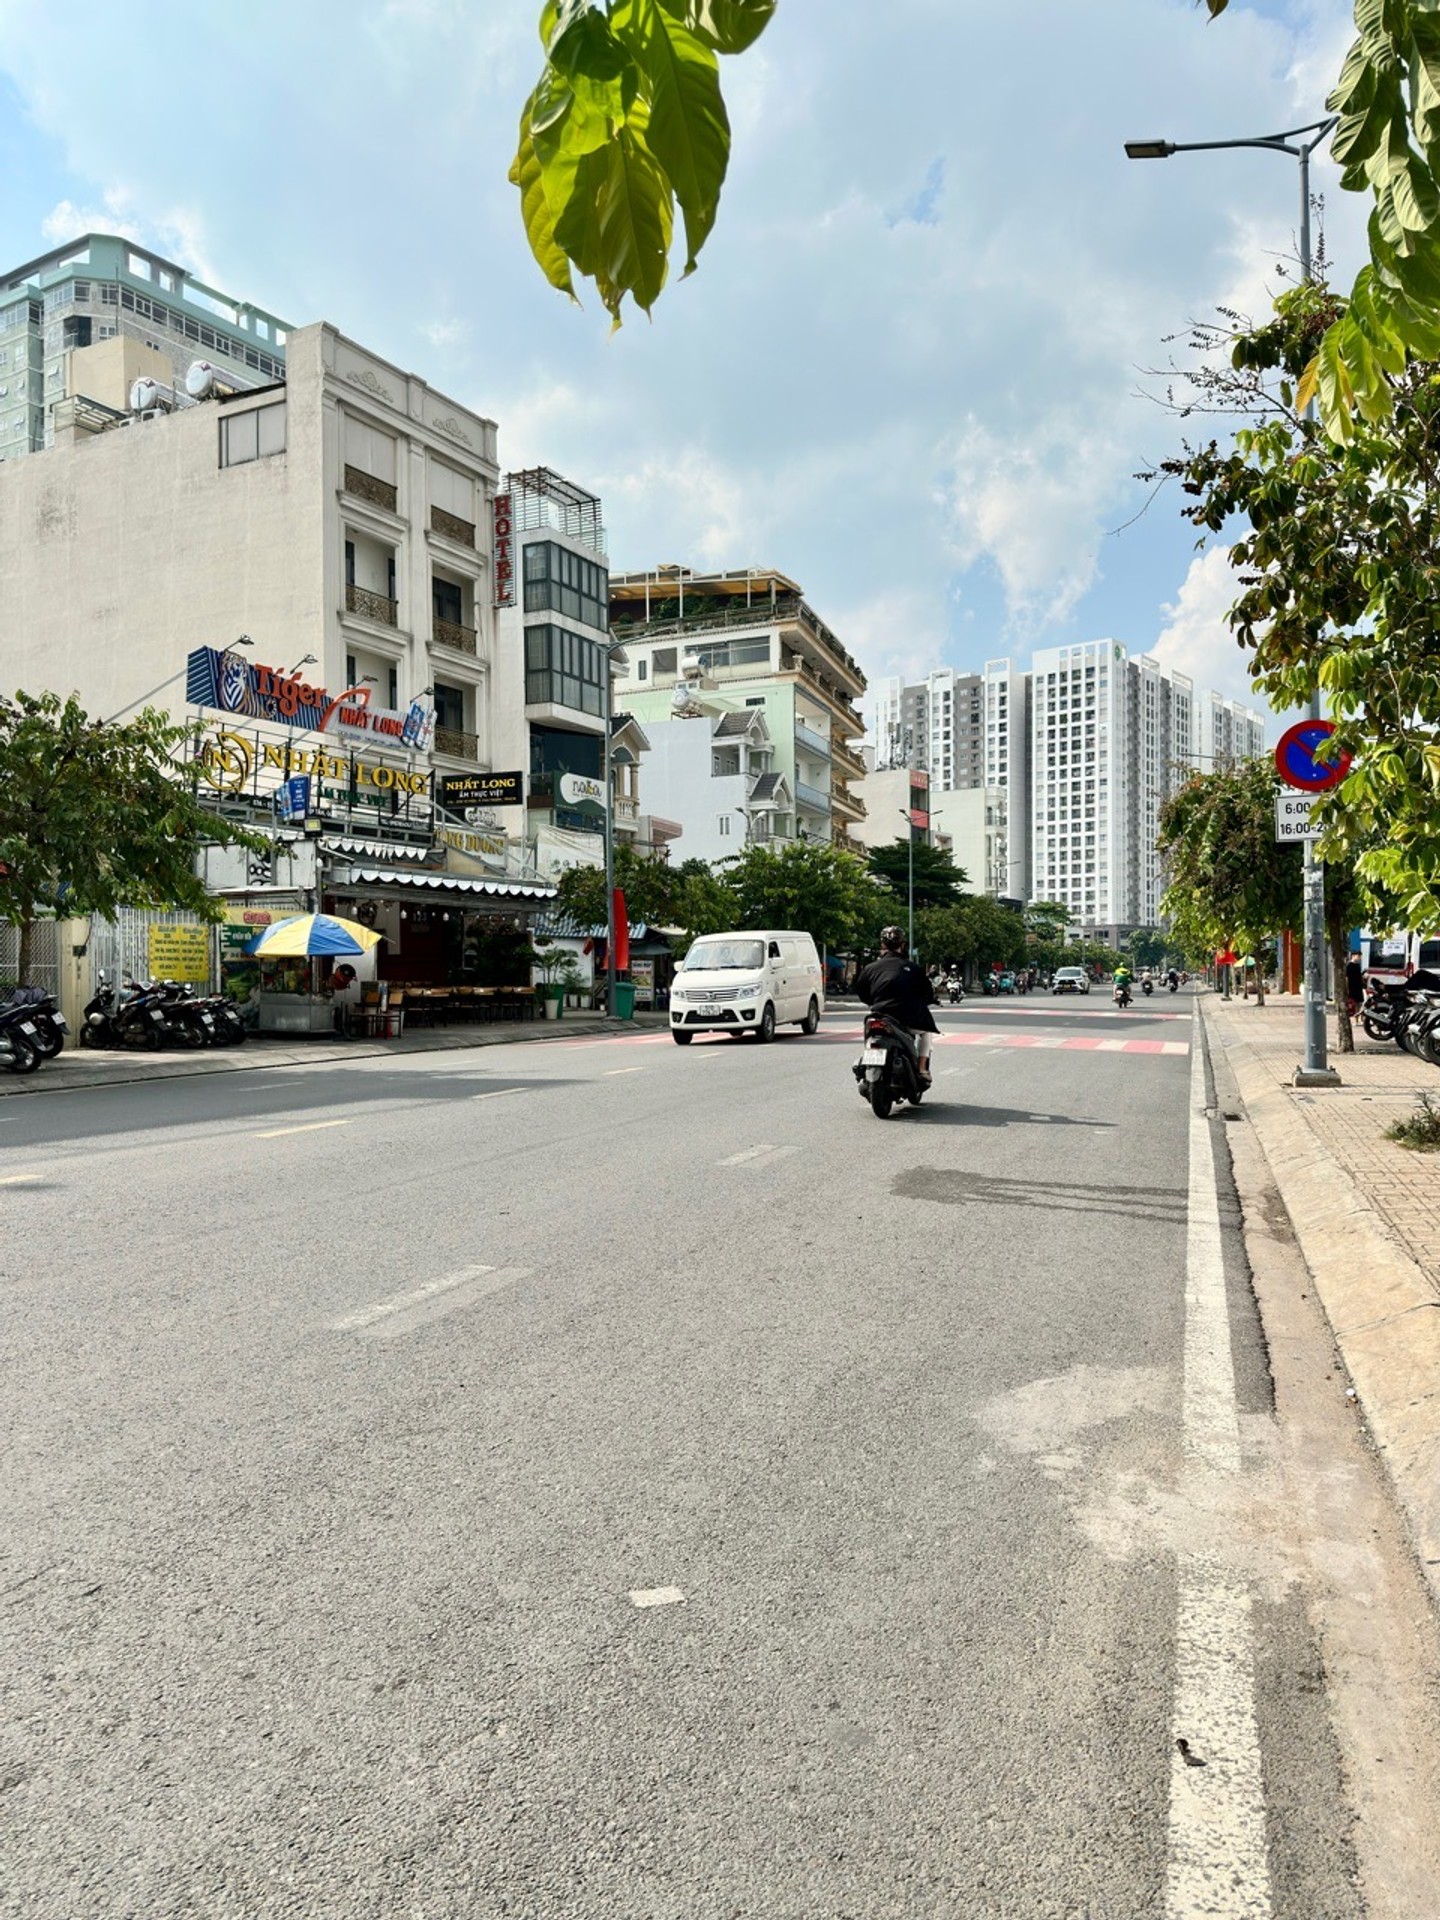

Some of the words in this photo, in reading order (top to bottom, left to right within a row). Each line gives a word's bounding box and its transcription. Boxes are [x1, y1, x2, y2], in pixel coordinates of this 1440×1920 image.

[494, 494, 513, 601] HOTEL
[254, 663, 327, 717] Tiger
[373, 714, 404, 737] LONG
[355, 760, 428, 796] LONG
[446, 776, 480, 791] NHẤT
[481, 777, 516, 790] LONG
[1280, 821, 1326, 836] 16:00-2
